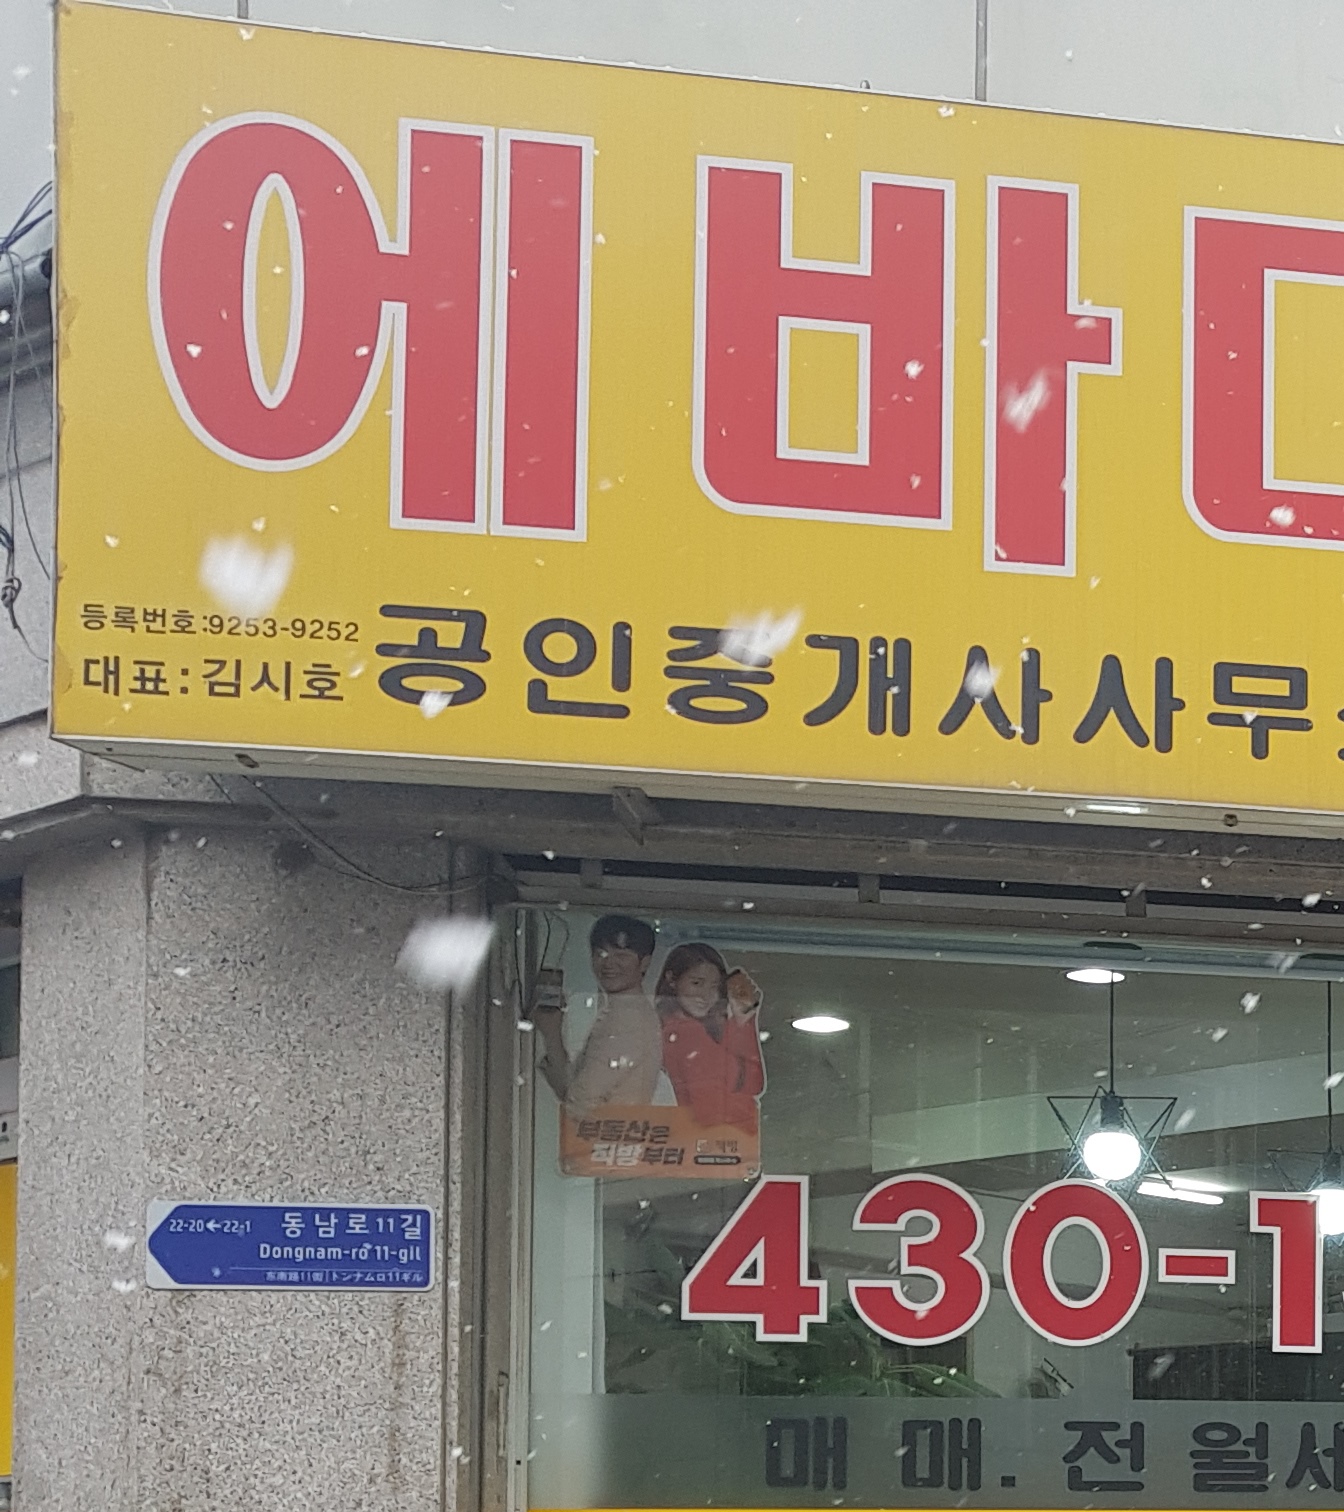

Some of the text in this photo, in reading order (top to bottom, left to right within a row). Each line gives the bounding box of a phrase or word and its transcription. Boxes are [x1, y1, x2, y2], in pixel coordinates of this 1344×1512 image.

[169, 1219, 204, 1233] 22-20
[259, 1243, 422, 1263] Dongnam-ro 11-gil
